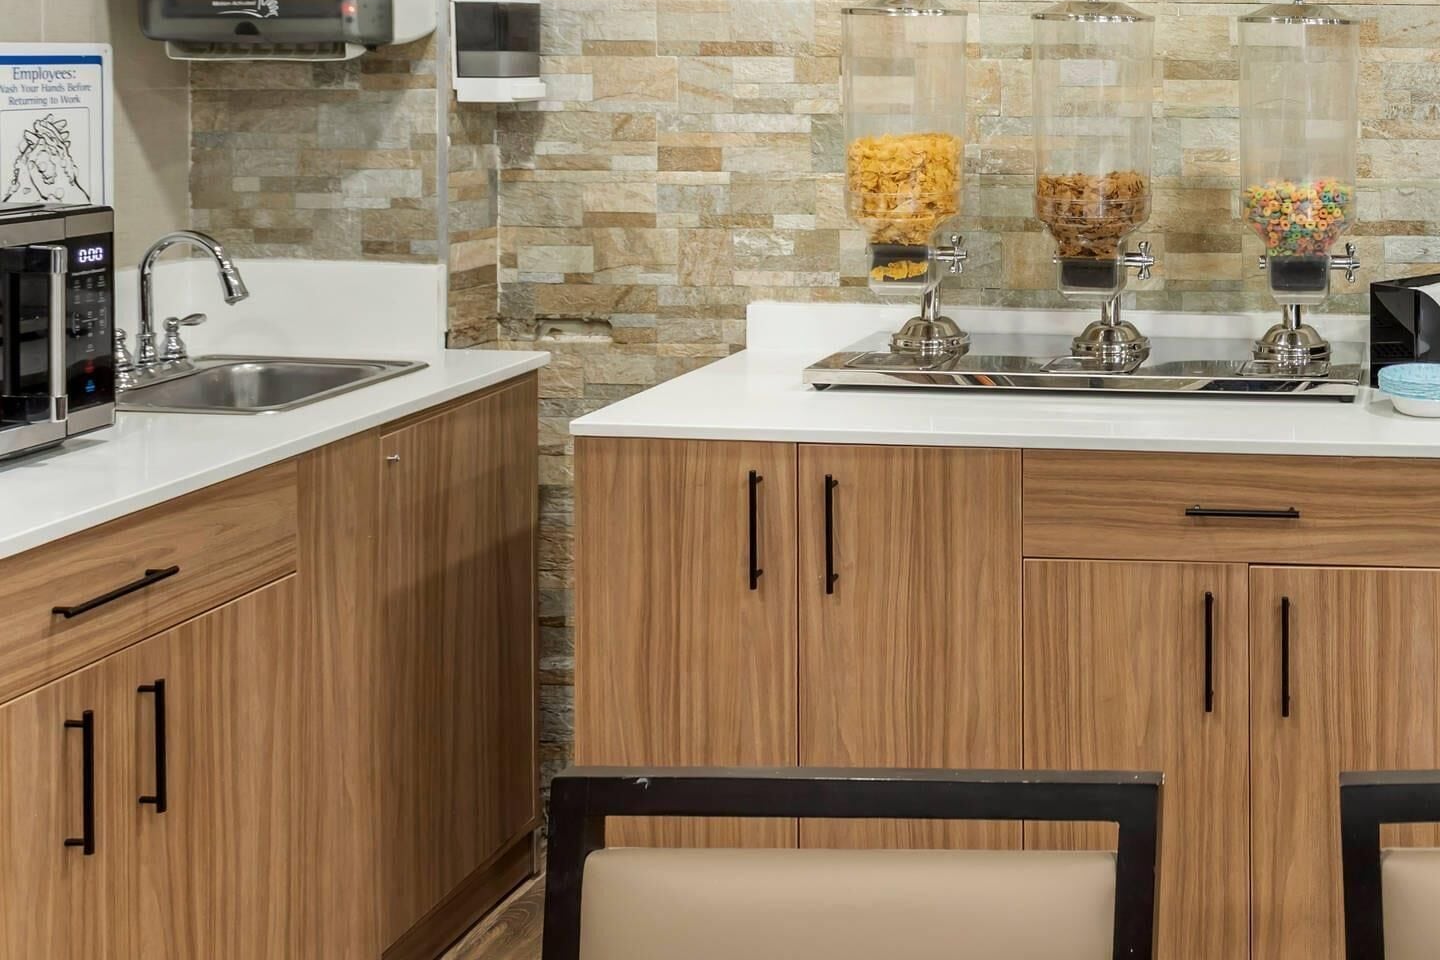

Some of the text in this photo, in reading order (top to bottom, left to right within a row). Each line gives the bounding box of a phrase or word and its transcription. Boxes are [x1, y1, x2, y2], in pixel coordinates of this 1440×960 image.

[13, 67, 77, 83] Employees:
[21, 84, 40, 93] Your
[41, 83, 66, 93] Hands
[67, 82, 92, 92] Before
[8, 94, 81, 107] Returning to Work
